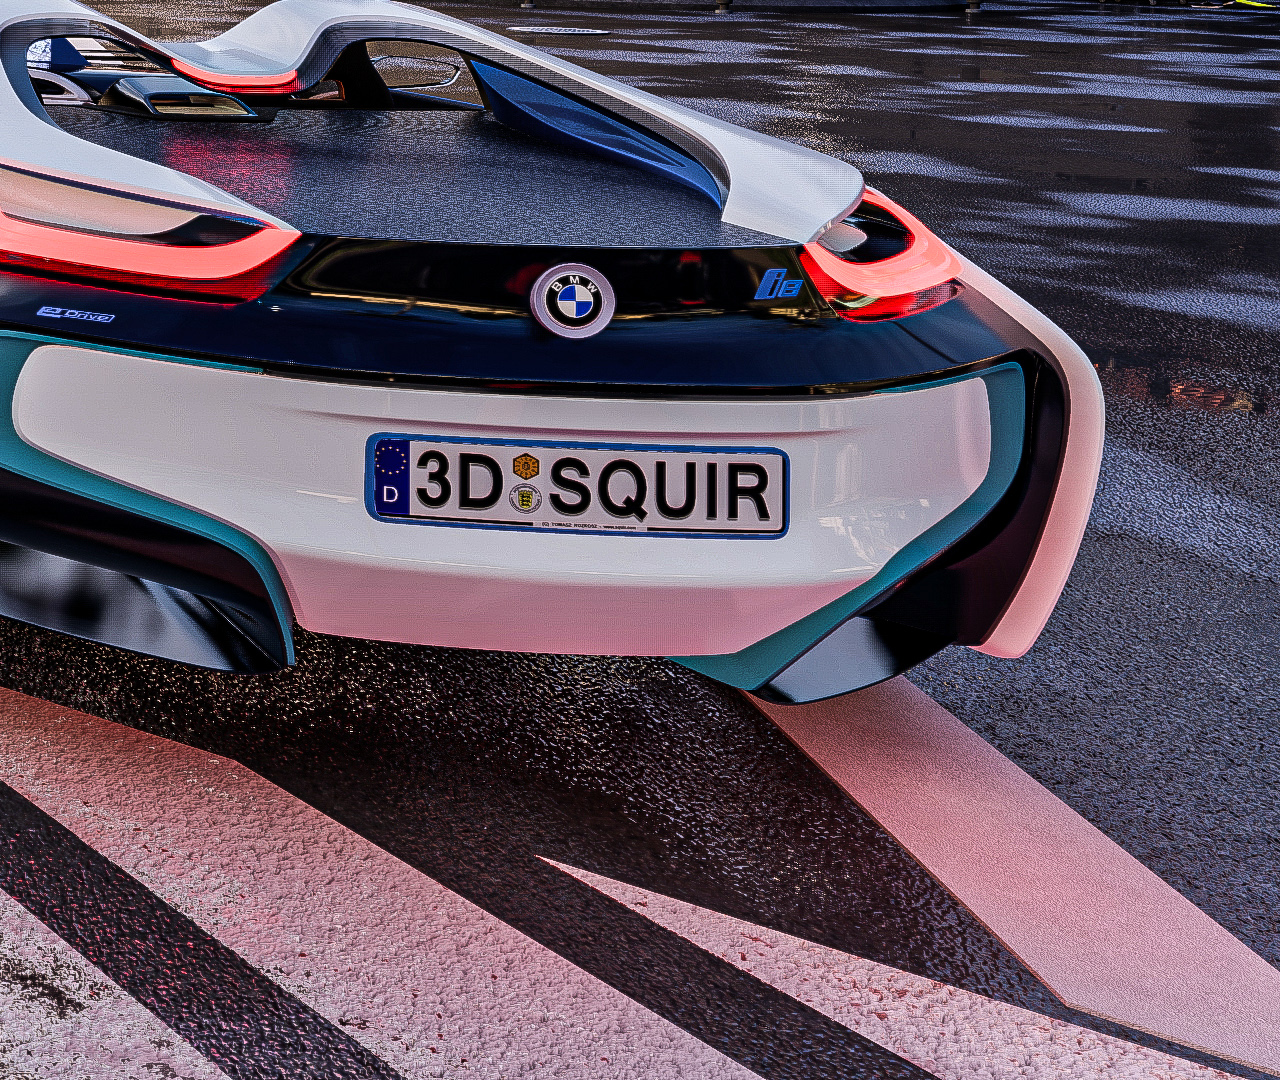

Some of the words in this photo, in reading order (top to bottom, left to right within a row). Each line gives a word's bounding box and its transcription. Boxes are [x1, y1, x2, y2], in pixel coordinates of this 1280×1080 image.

[551, 275, 598, 294] BMW
[754, 268, 804, 300] i8
[382, 485, 399, 503] D
[415, 449, 505, 510] 3D
[548, 456, 771, 521] SQUIR
